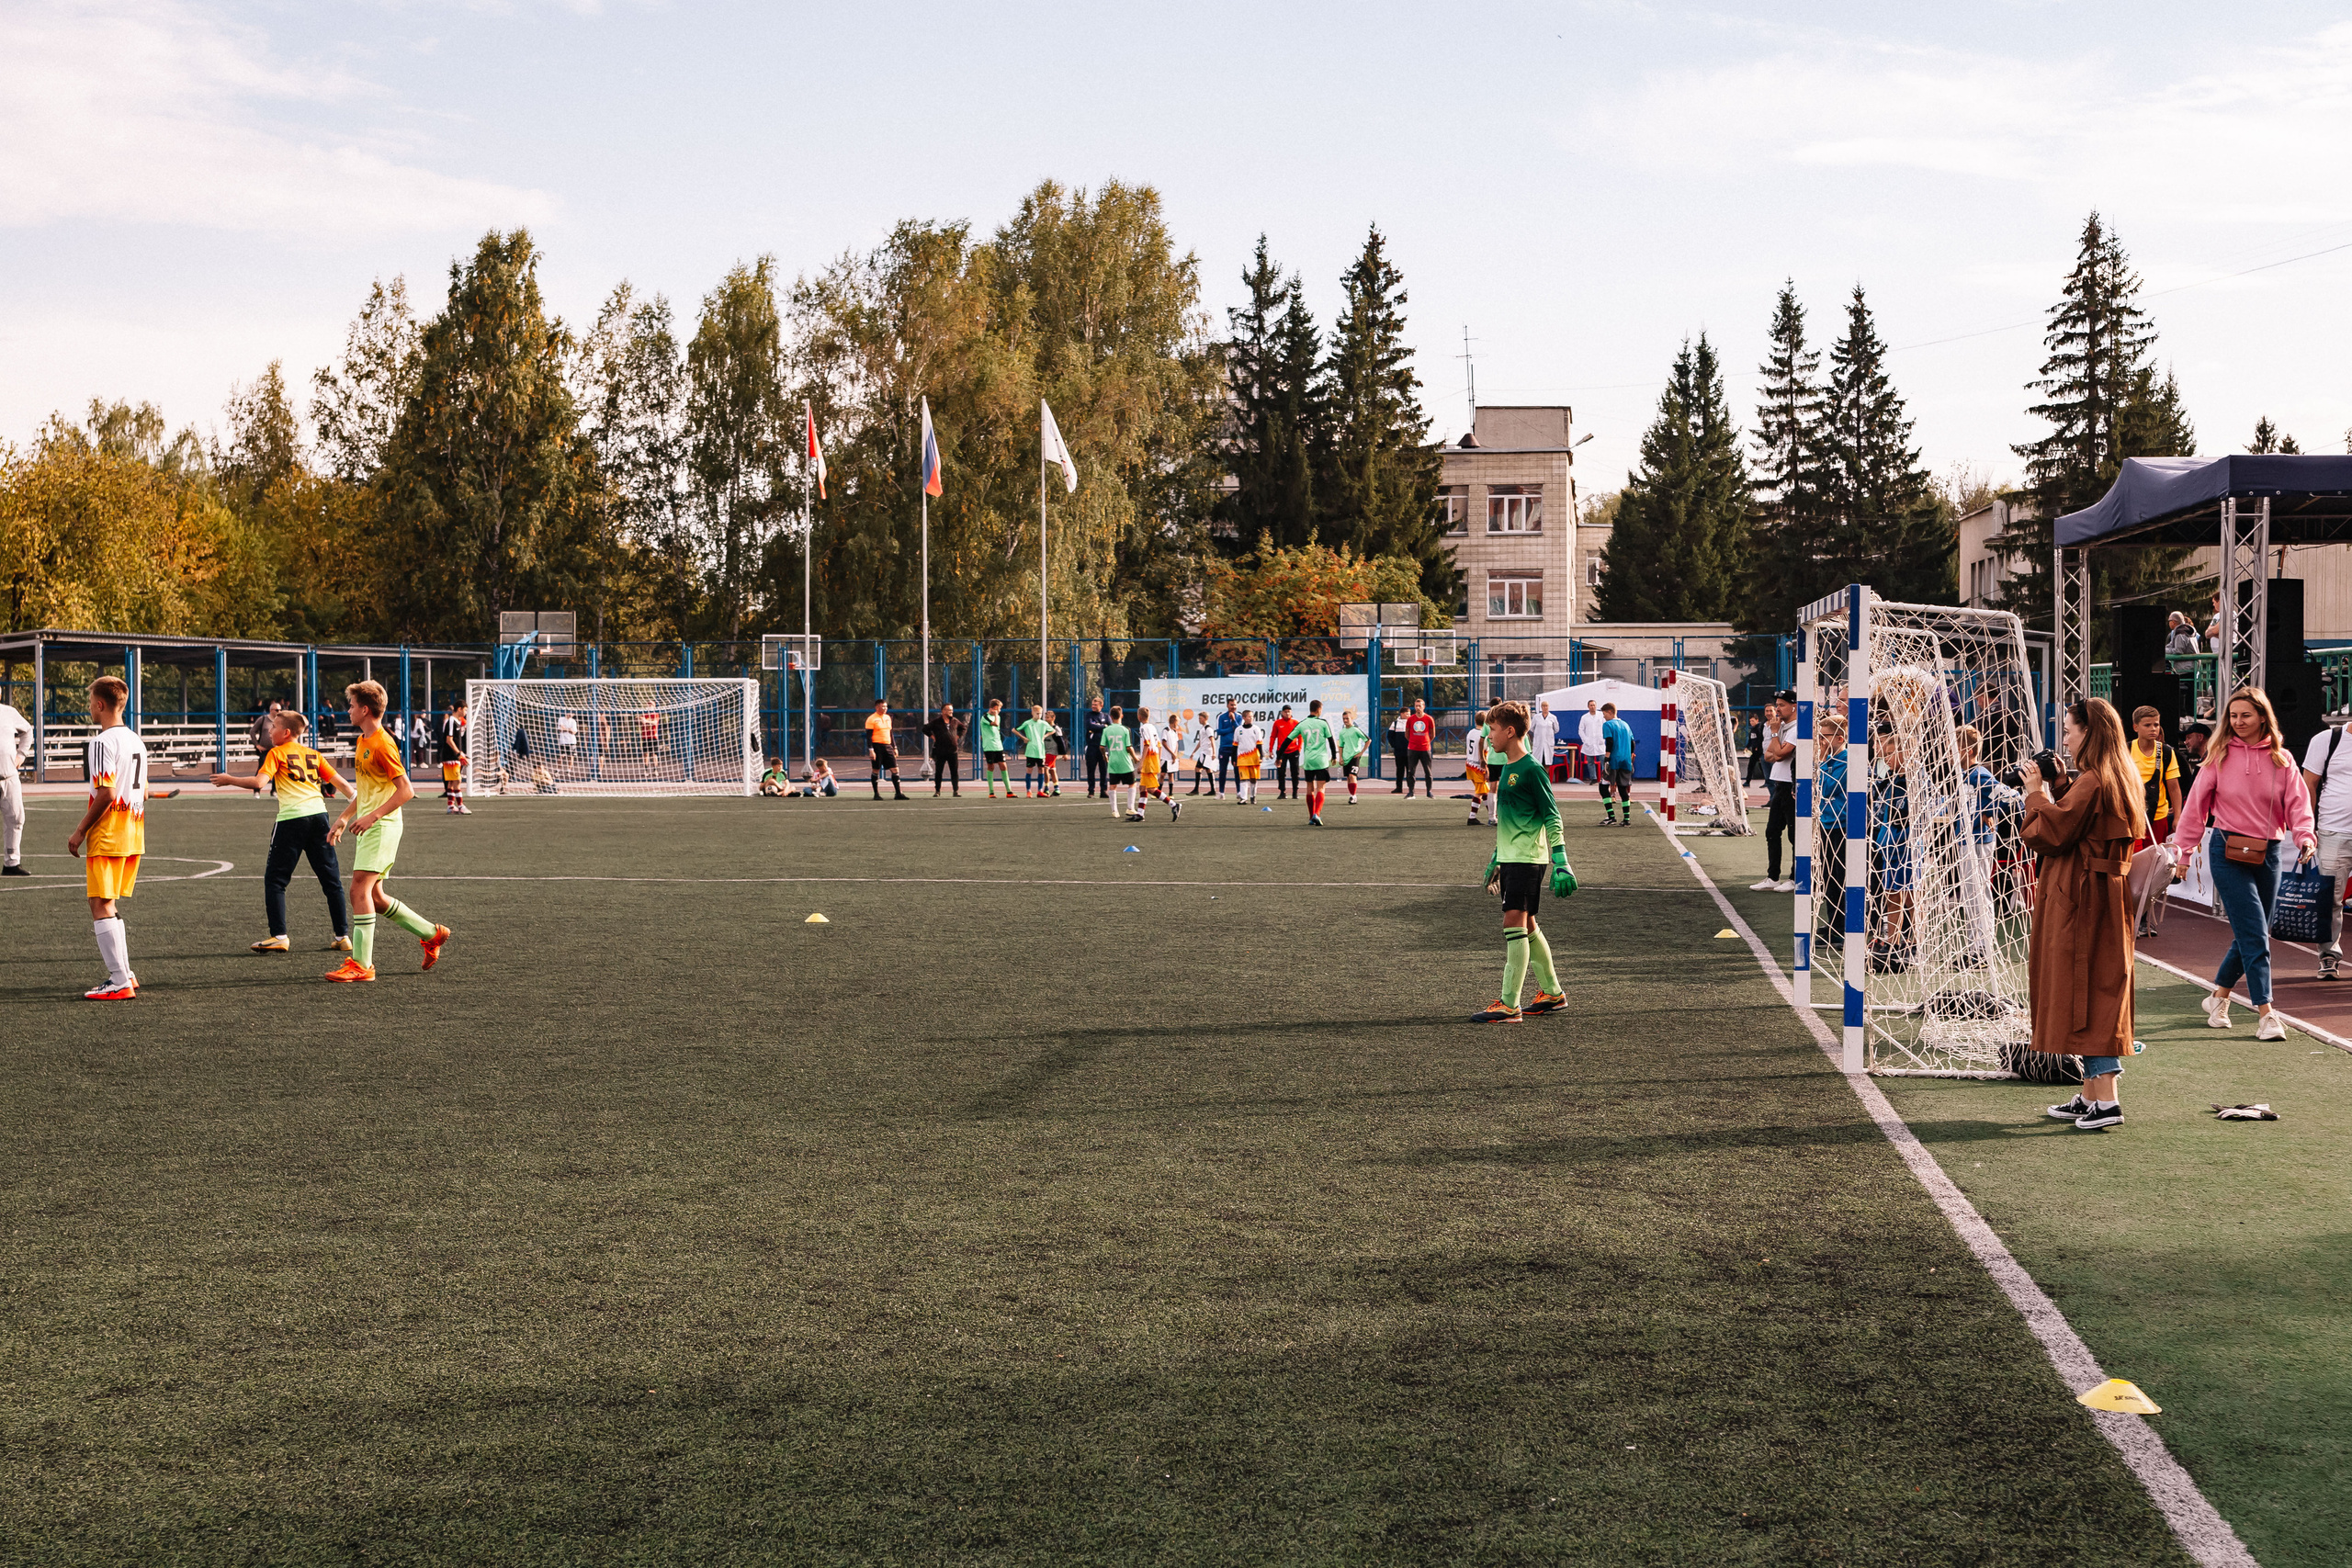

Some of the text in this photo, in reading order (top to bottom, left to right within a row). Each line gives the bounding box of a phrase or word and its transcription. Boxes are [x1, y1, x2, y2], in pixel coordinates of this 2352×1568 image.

[1108, 735, 1123, 751] 25
[1468, 739, 1475, 754] 5
[287, 754, 319, 783] 55
